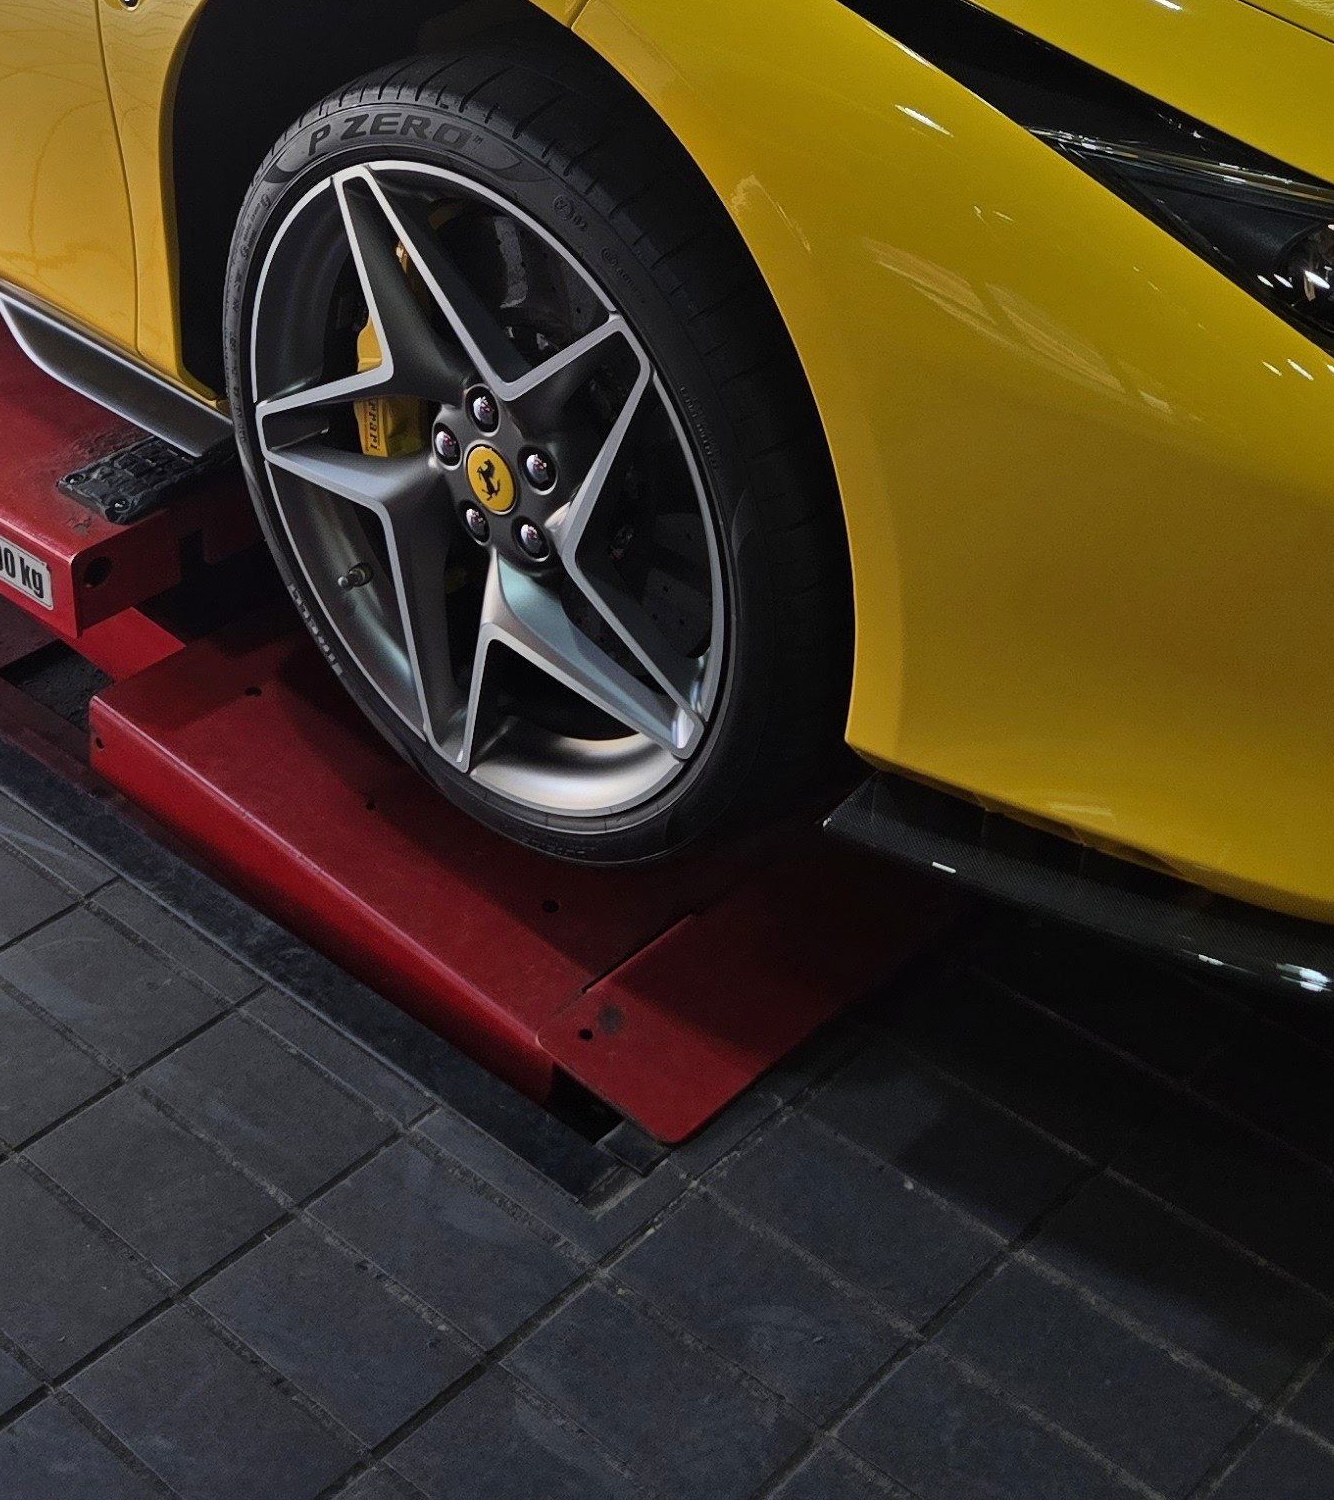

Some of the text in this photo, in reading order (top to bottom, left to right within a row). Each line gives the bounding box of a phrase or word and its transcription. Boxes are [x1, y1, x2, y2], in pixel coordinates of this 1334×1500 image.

[308, 112, 473, 156] P ZERO
[19, 554, 44, 599] kg
